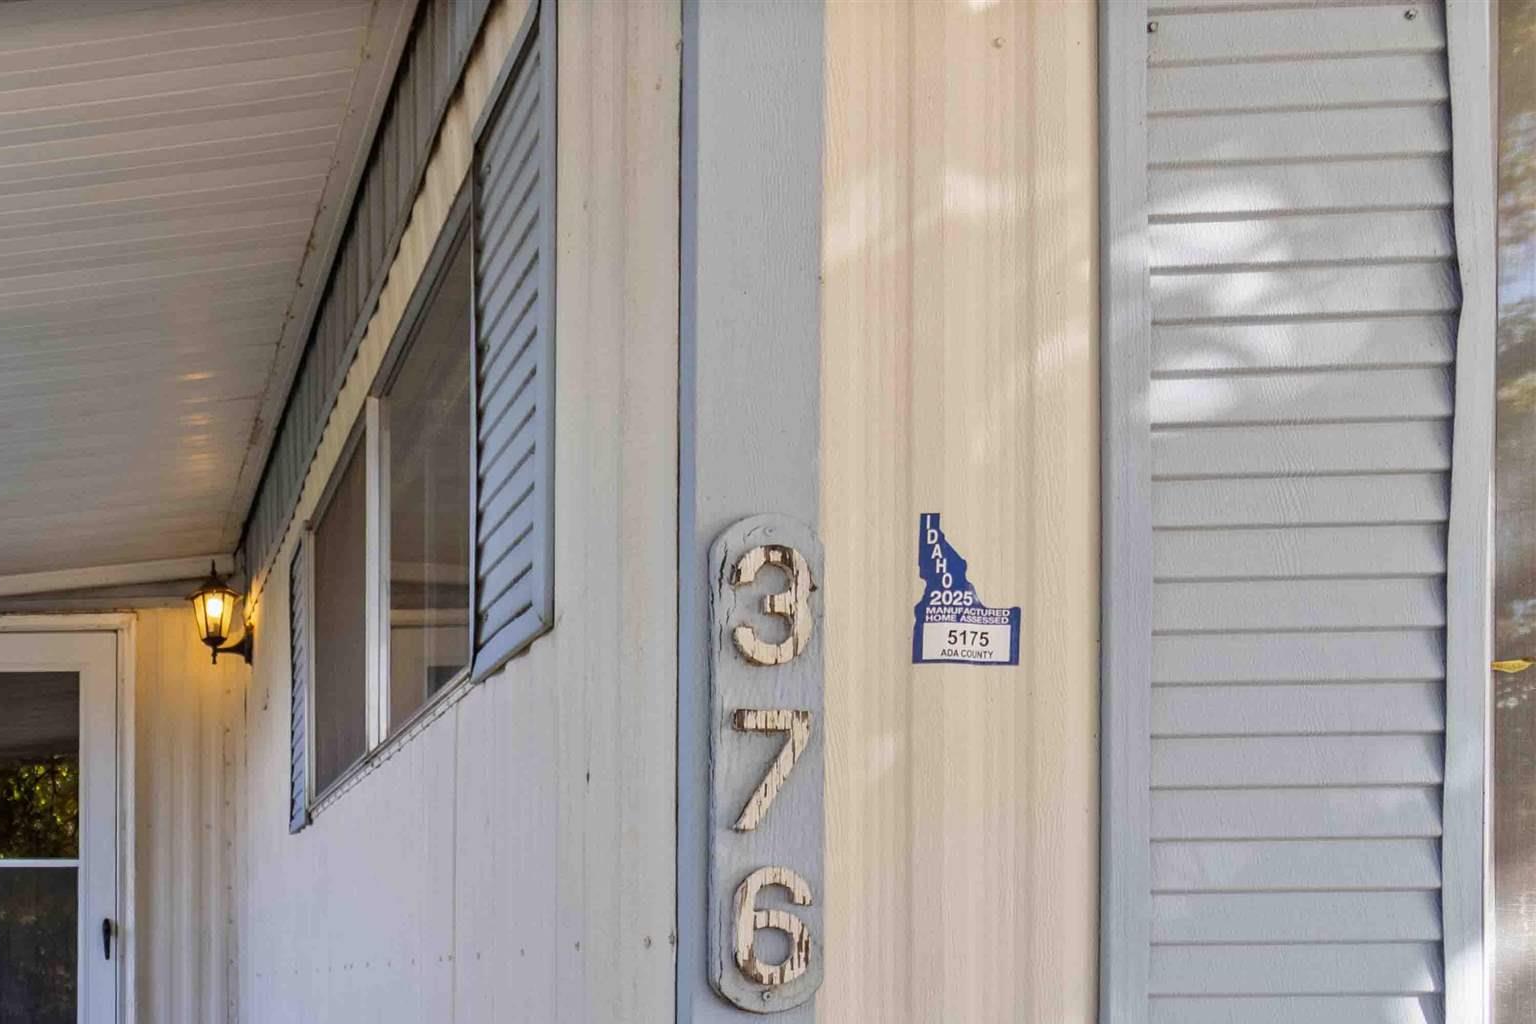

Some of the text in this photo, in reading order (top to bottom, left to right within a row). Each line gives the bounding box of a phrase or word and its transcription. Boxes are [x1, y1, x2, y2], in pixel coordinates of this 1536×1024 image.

[926, 514, 953, 589] IDAHO
[929, 590, 974, 606] 2025
[925, 606, 1011, 617] MANUFACTURED
[925, 614, 1010, 625] HOME ASSESSED
[947, 629, 990, 648] 5175
[940, 648, 994, 660] ADA COUNTY
[729, 543, 818, 986] 376
